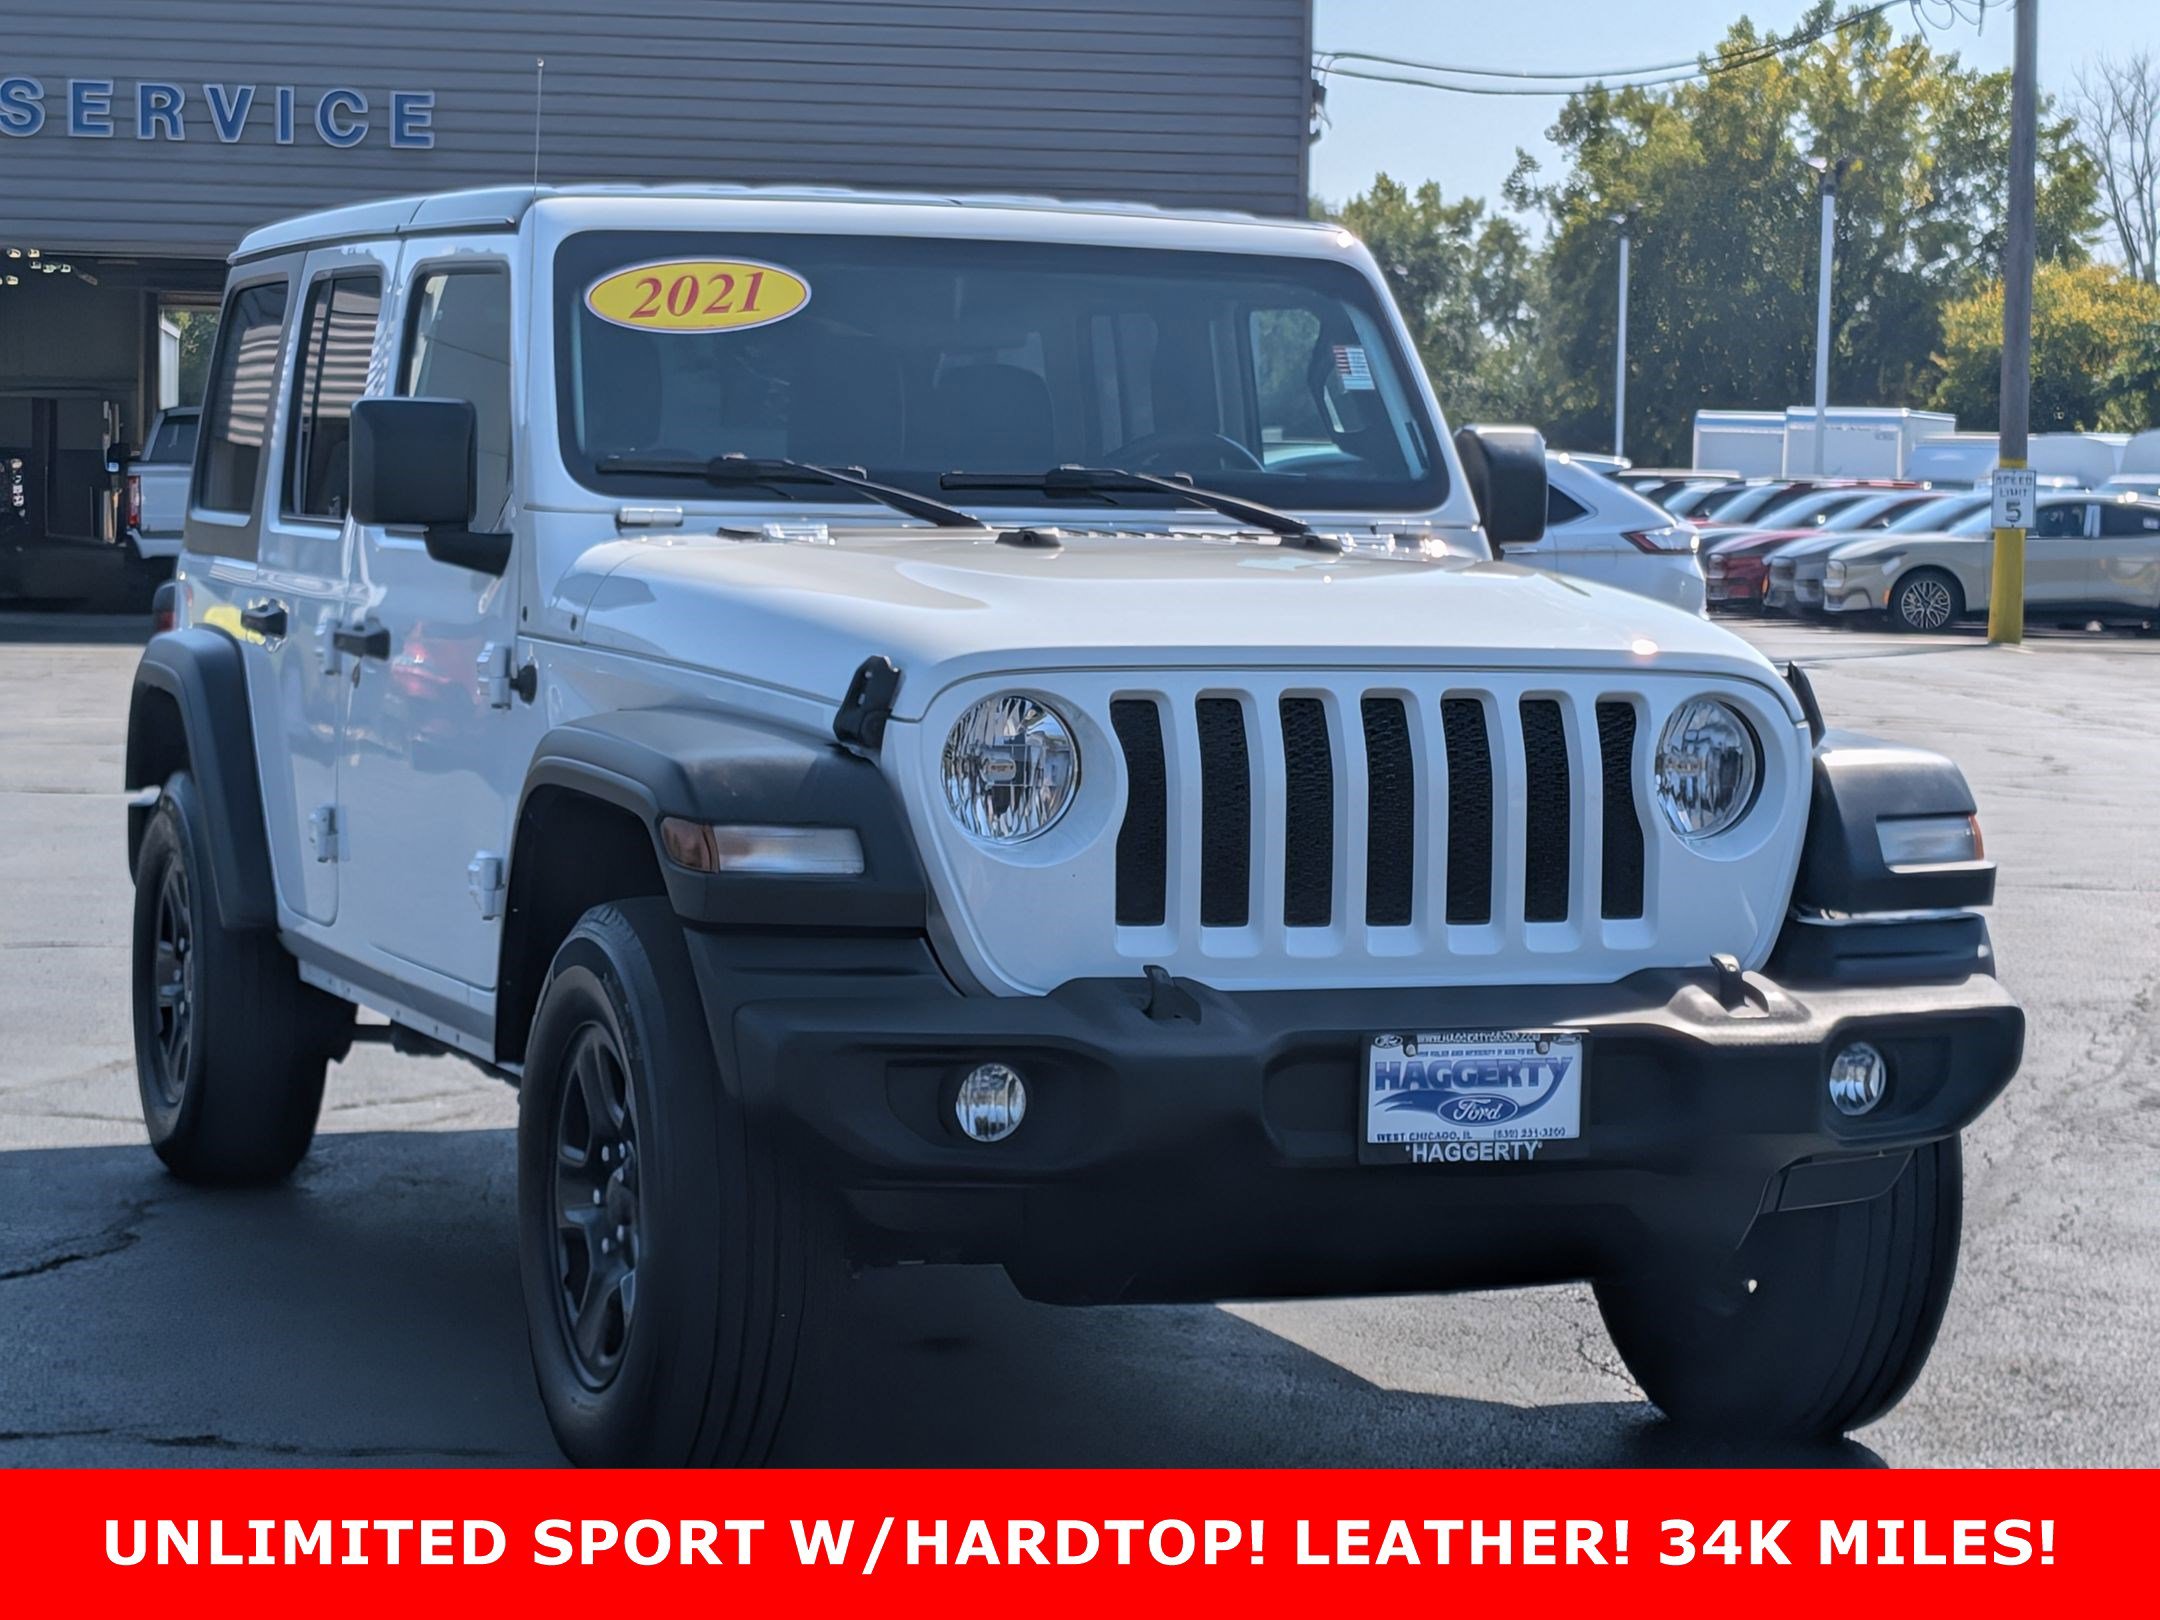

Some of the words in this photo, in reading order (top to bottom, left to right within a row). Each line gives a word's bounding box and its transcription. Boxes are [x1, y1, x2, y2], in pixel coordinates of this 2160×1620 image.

[0, 75, 435, 149] SERVICE
[629, 271, 764, 319] 2021
[2000, 488, 2027, 497] LIMIT
[2005, 500, 2021, 523] 5
[1375, 1057, 1573, 1091] HAGGERTY
[1453, 1099, 1502, 1121] Ford
[1412, 1141, 1538, 1163] HAGGERTY
